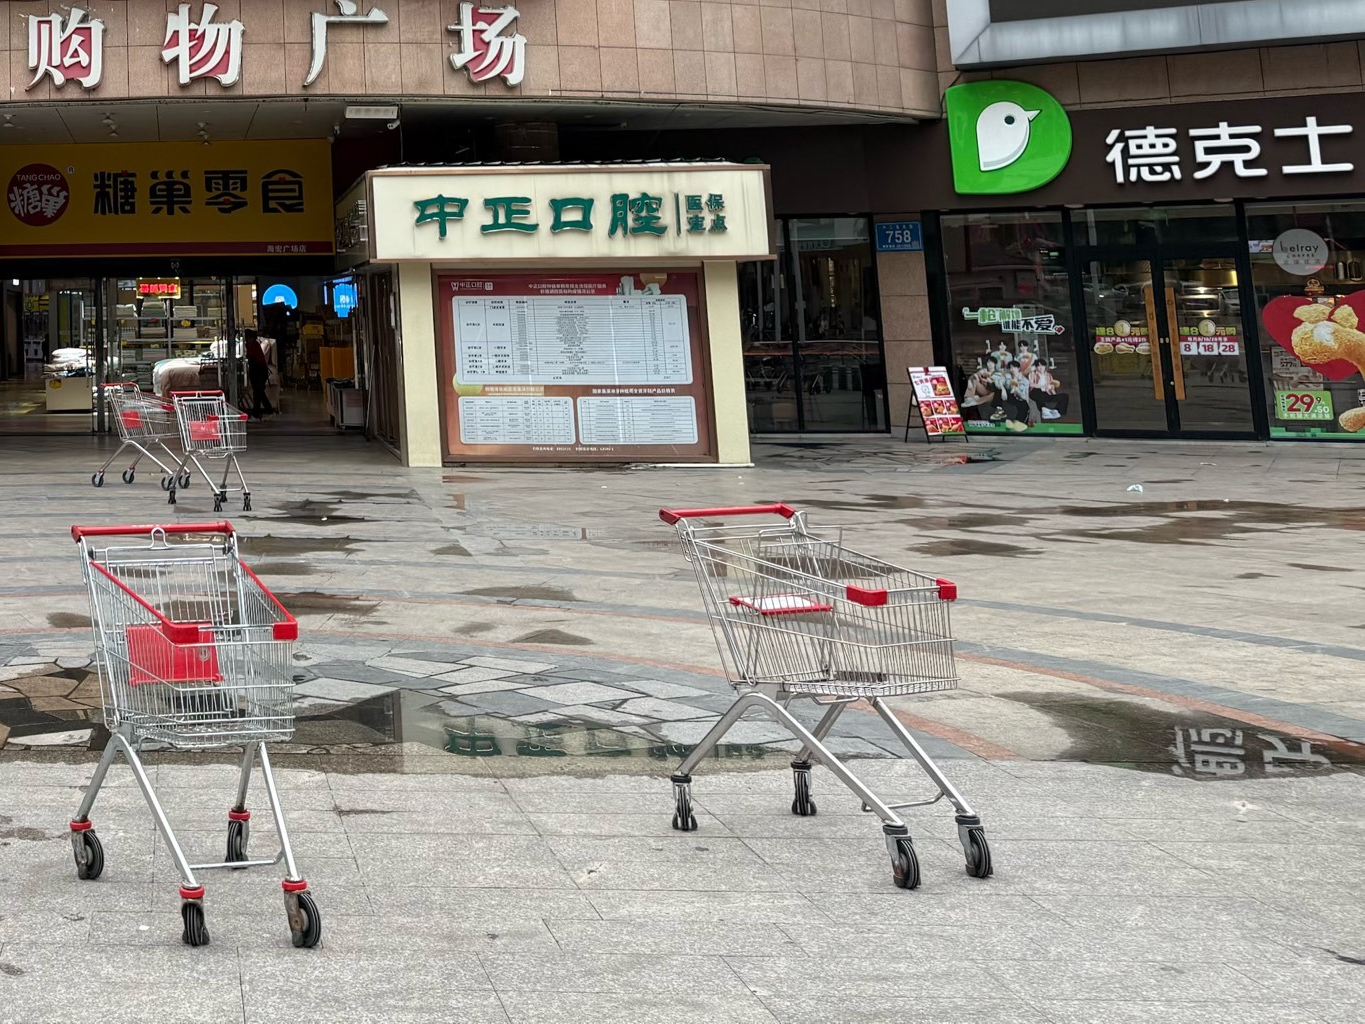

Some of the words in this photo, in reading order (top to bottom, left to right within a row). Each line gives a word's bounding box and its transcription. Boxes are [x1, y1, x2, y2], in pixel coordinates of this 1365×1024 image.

[1104, 116, 1355, 184] 德克士
[8, 183, 68, 218] 糖巢
[93, 168, 305, 216] 糖巢零食
[685, 193, 726, 212] 医保
[414, 193, 668, 240] 中正口腔
[686, 214, 729, 233] 定点
[885, 229, 912, 243] 758
[1184, 344, 1192, 352] 8
[1202, 344, 1215, 353] 18
[1221, 344, 1236, 353] 28
[1285, 393, 1315, 414] 29
